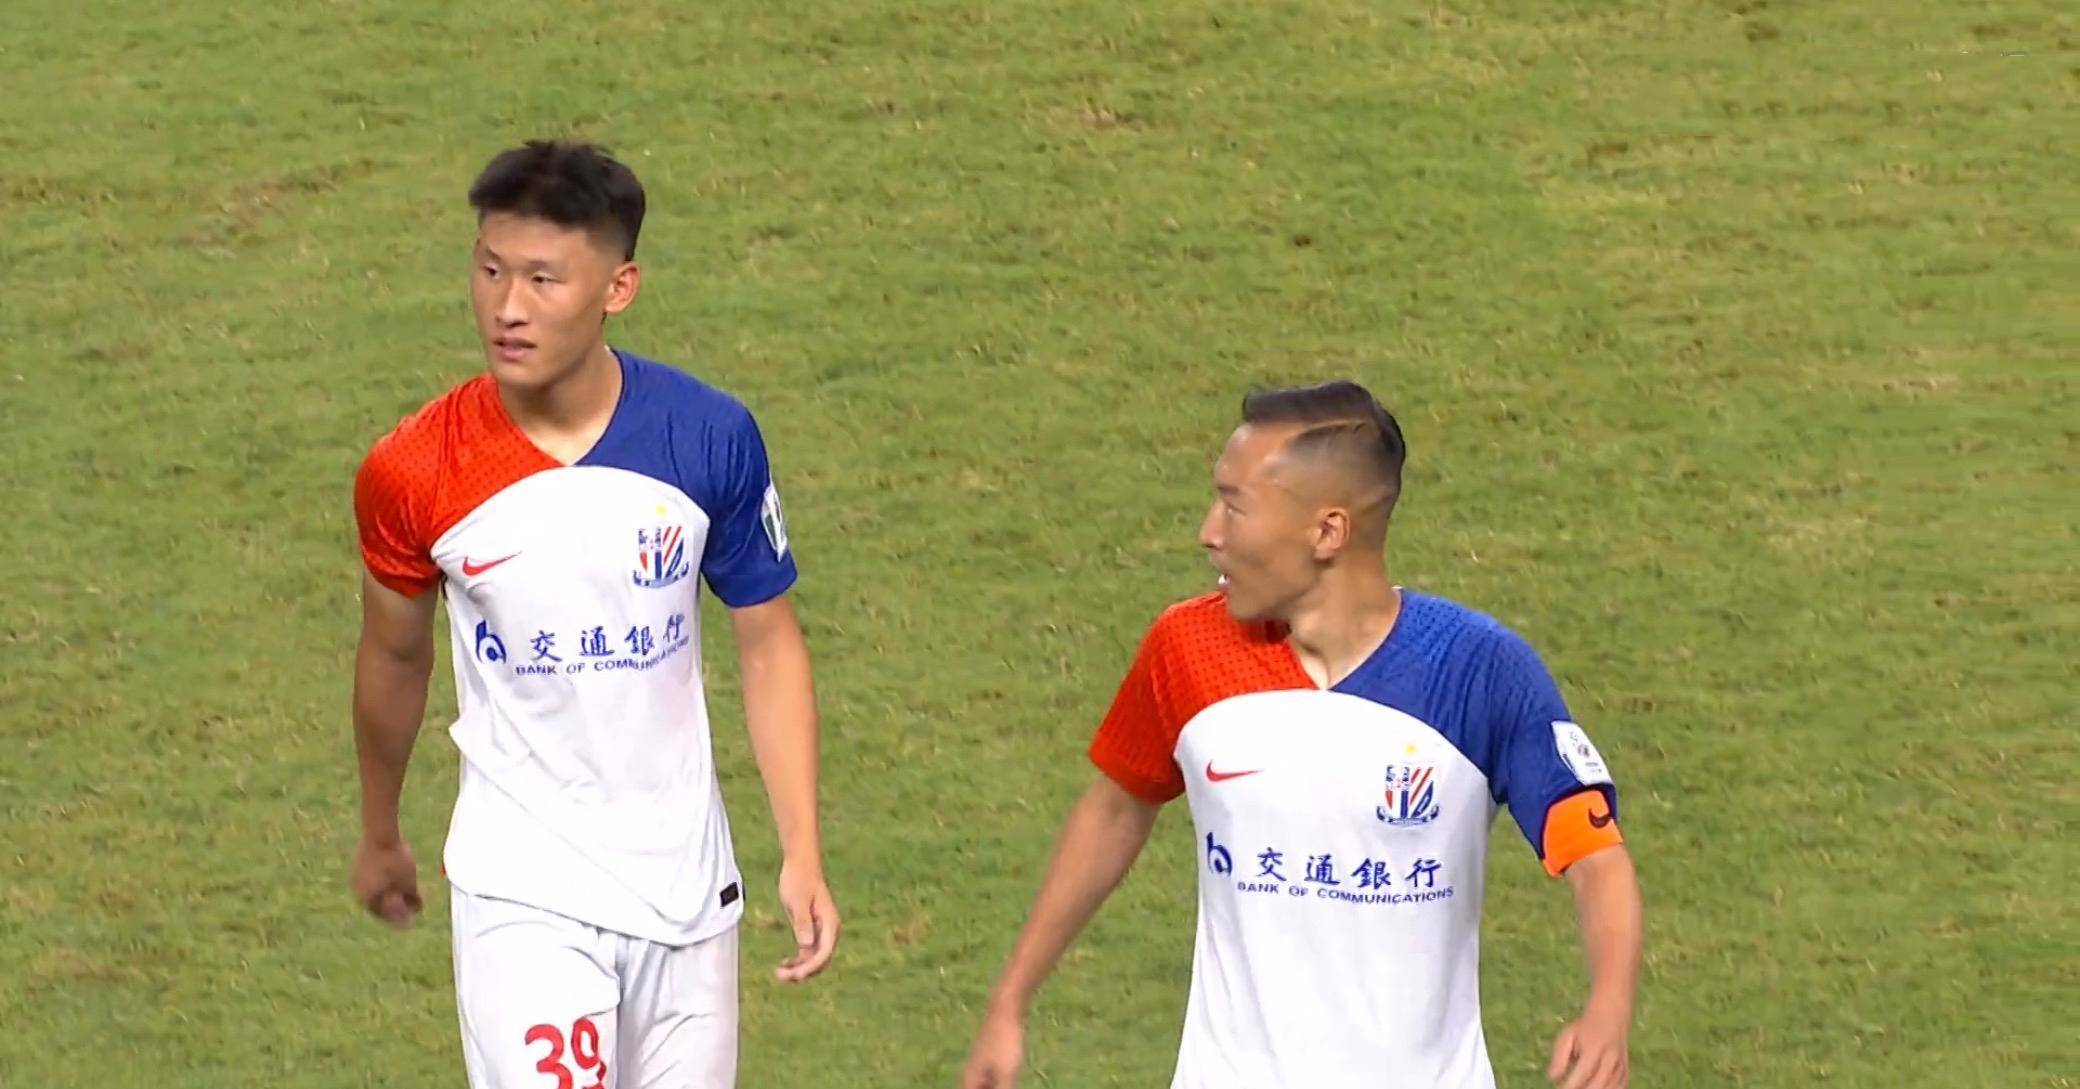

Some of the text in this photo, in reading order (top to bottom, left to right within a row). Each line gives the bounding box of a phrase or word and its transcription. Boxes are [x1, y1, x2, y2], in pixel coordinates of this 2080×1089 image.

[516, 636, 689, 676] BANK OF COMMUNA
[1256, 846, 1442, 889] 交通銀行
[1237, 881, 1455, 905] BANK OF COMMUNICATIONS
[525, 1016, 607, 1089] 39
